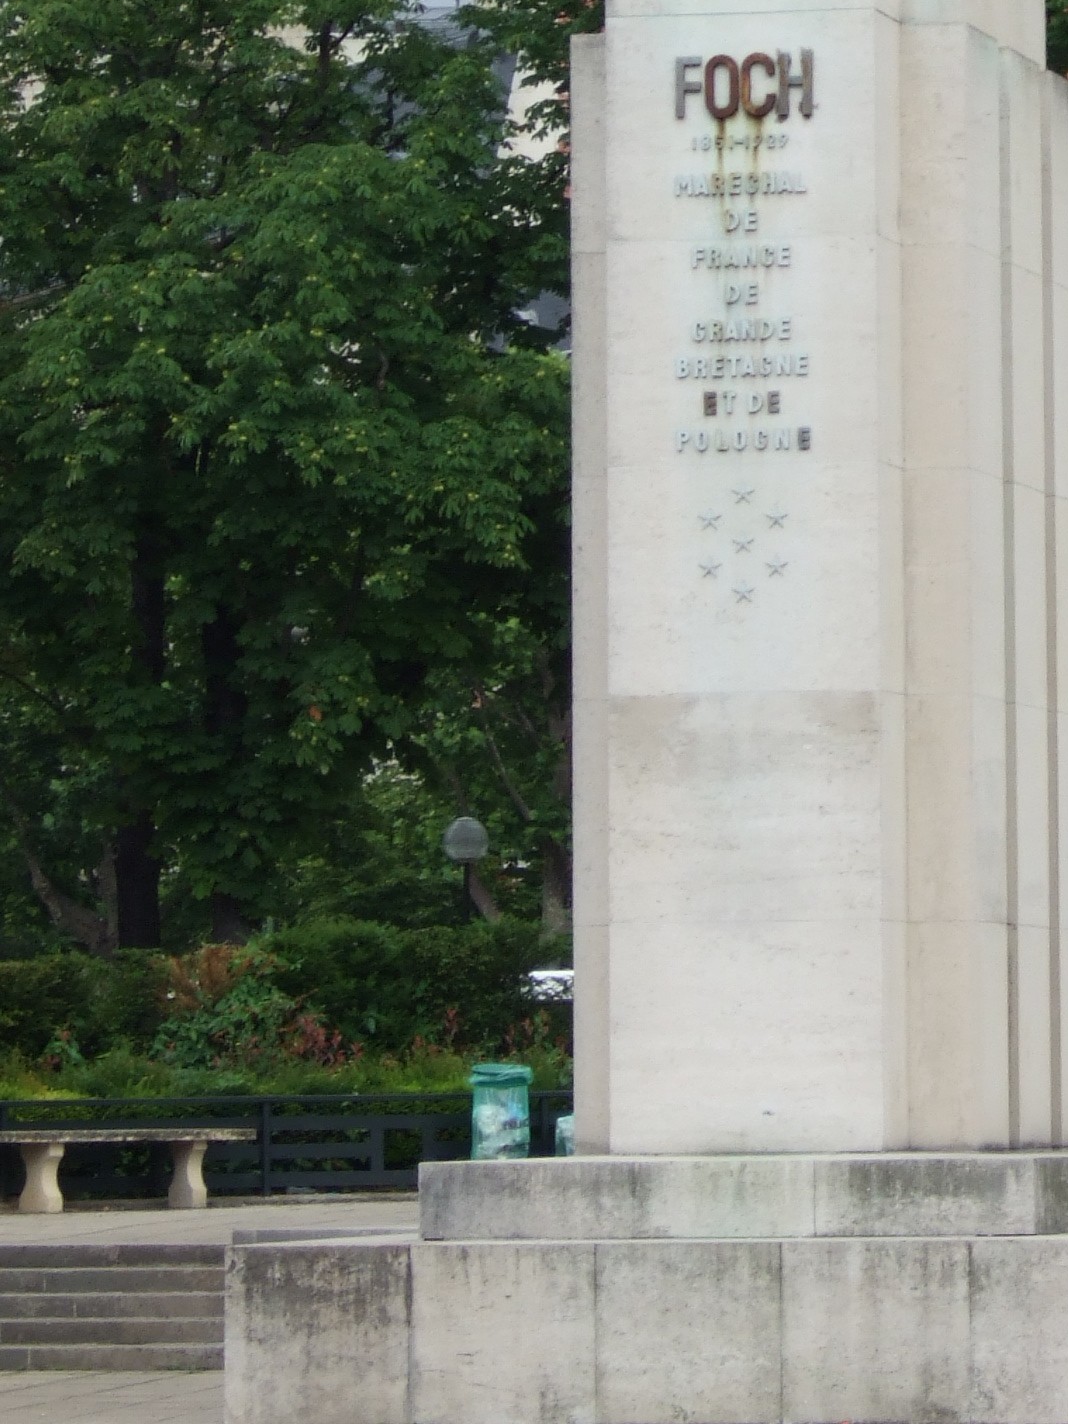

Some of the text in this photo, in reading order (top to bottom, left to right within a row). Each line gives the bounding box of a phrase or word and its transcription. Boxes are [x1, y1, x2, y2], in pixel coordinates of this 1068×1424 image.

[675, 48, 814, 122] FOCH
[691, 133, 789, 152] 1851-1929
[724, 208, 760, 233] DE
[691, 245, 792, 269] FRANCE
[724, 282, 759, 306] DE
[692, 317, 792, 343] GRANDE
[674, 354, 809, 379] BRETAGNE
[703, 390, 781, 416] ET DE
[674, 426, 811, 453] POLOGNE
